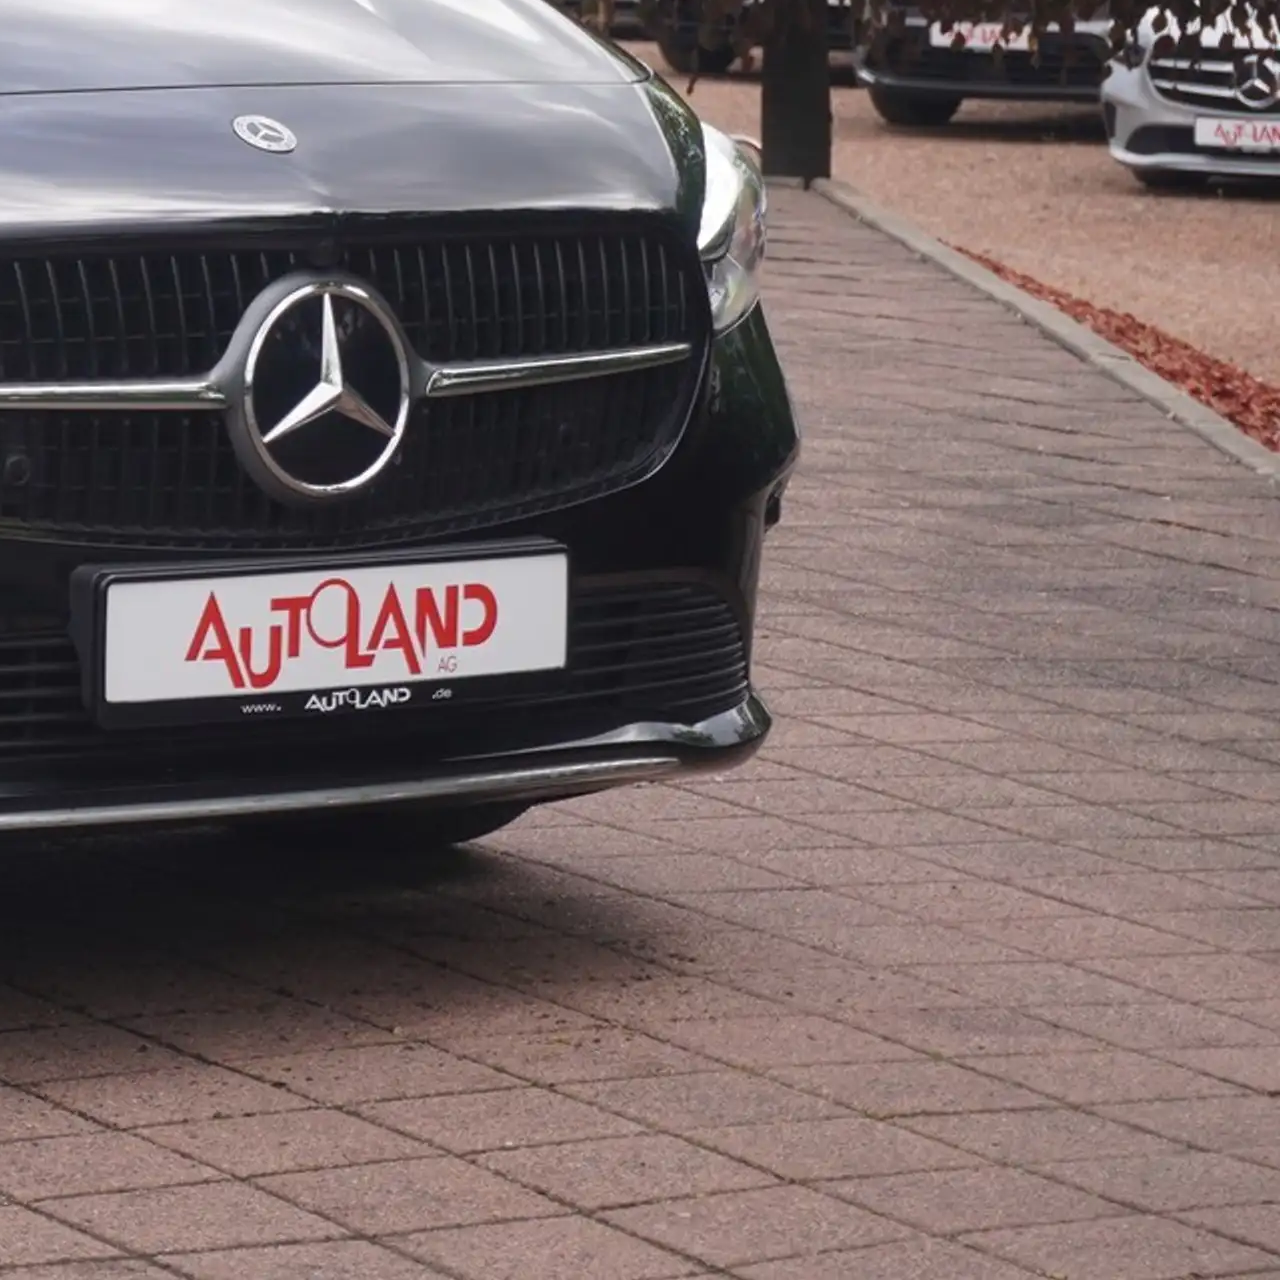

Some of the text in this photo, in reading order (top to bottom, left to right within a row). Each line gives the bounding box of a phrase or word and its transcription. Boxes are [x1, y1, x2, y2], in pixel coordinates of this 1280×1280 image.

[185, 578, 497, 689] AUTOLAND
[438, 656, 457, 673] AG
[241, 688, 452, 714] www. AUTOLAND .de
